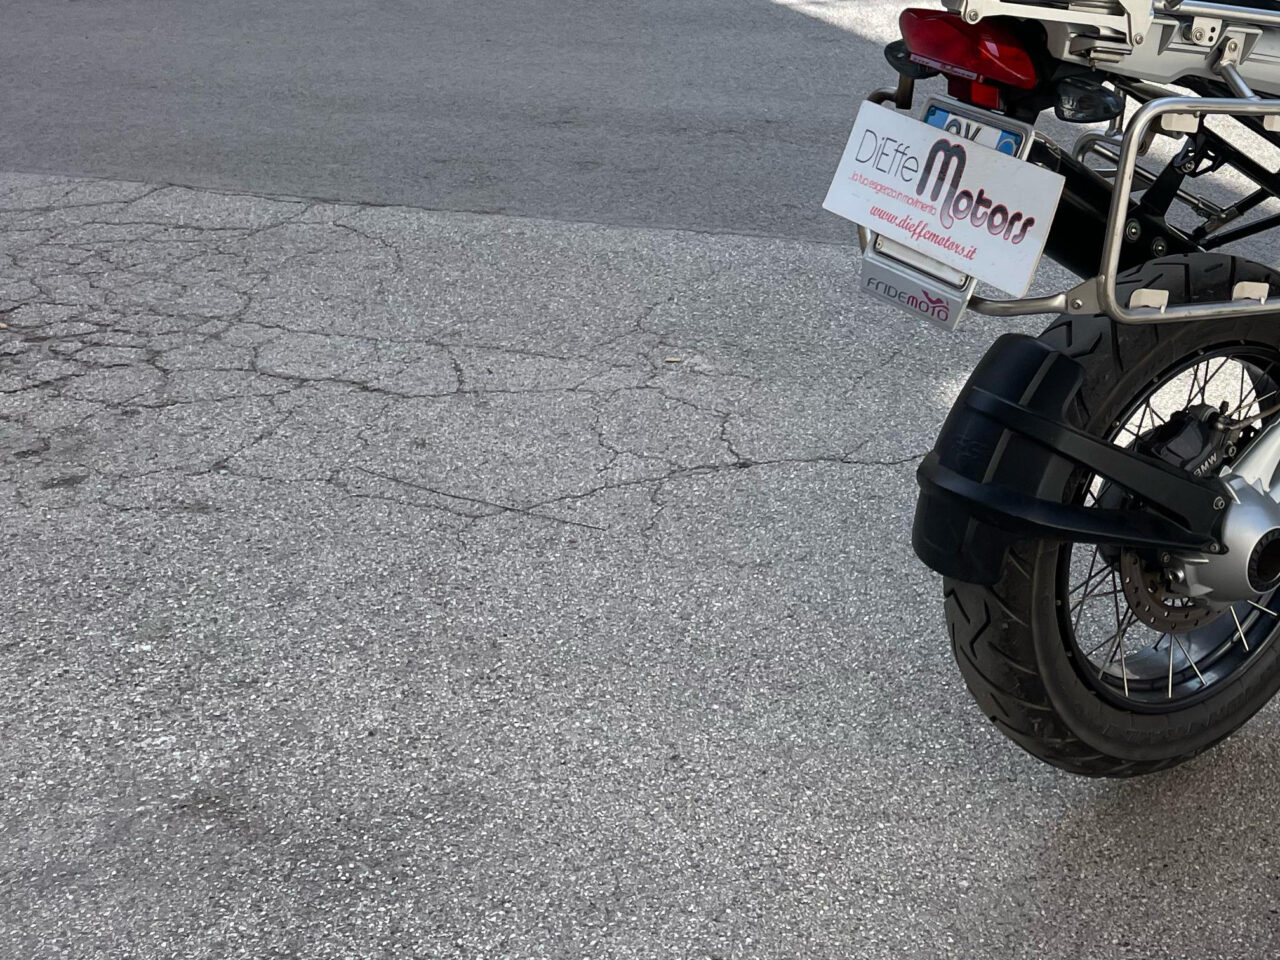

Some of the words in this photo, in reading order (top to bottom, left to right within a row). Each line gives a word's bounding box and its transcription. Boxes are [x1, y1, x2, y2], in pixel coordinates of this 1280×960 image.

[855, 128, 919, 182] DiEffe
[915, 138, 1035, 245] Motors
[903, 193, 937, 216] movimento
[869, 204, 978, 261] www.dieffemotors.it
